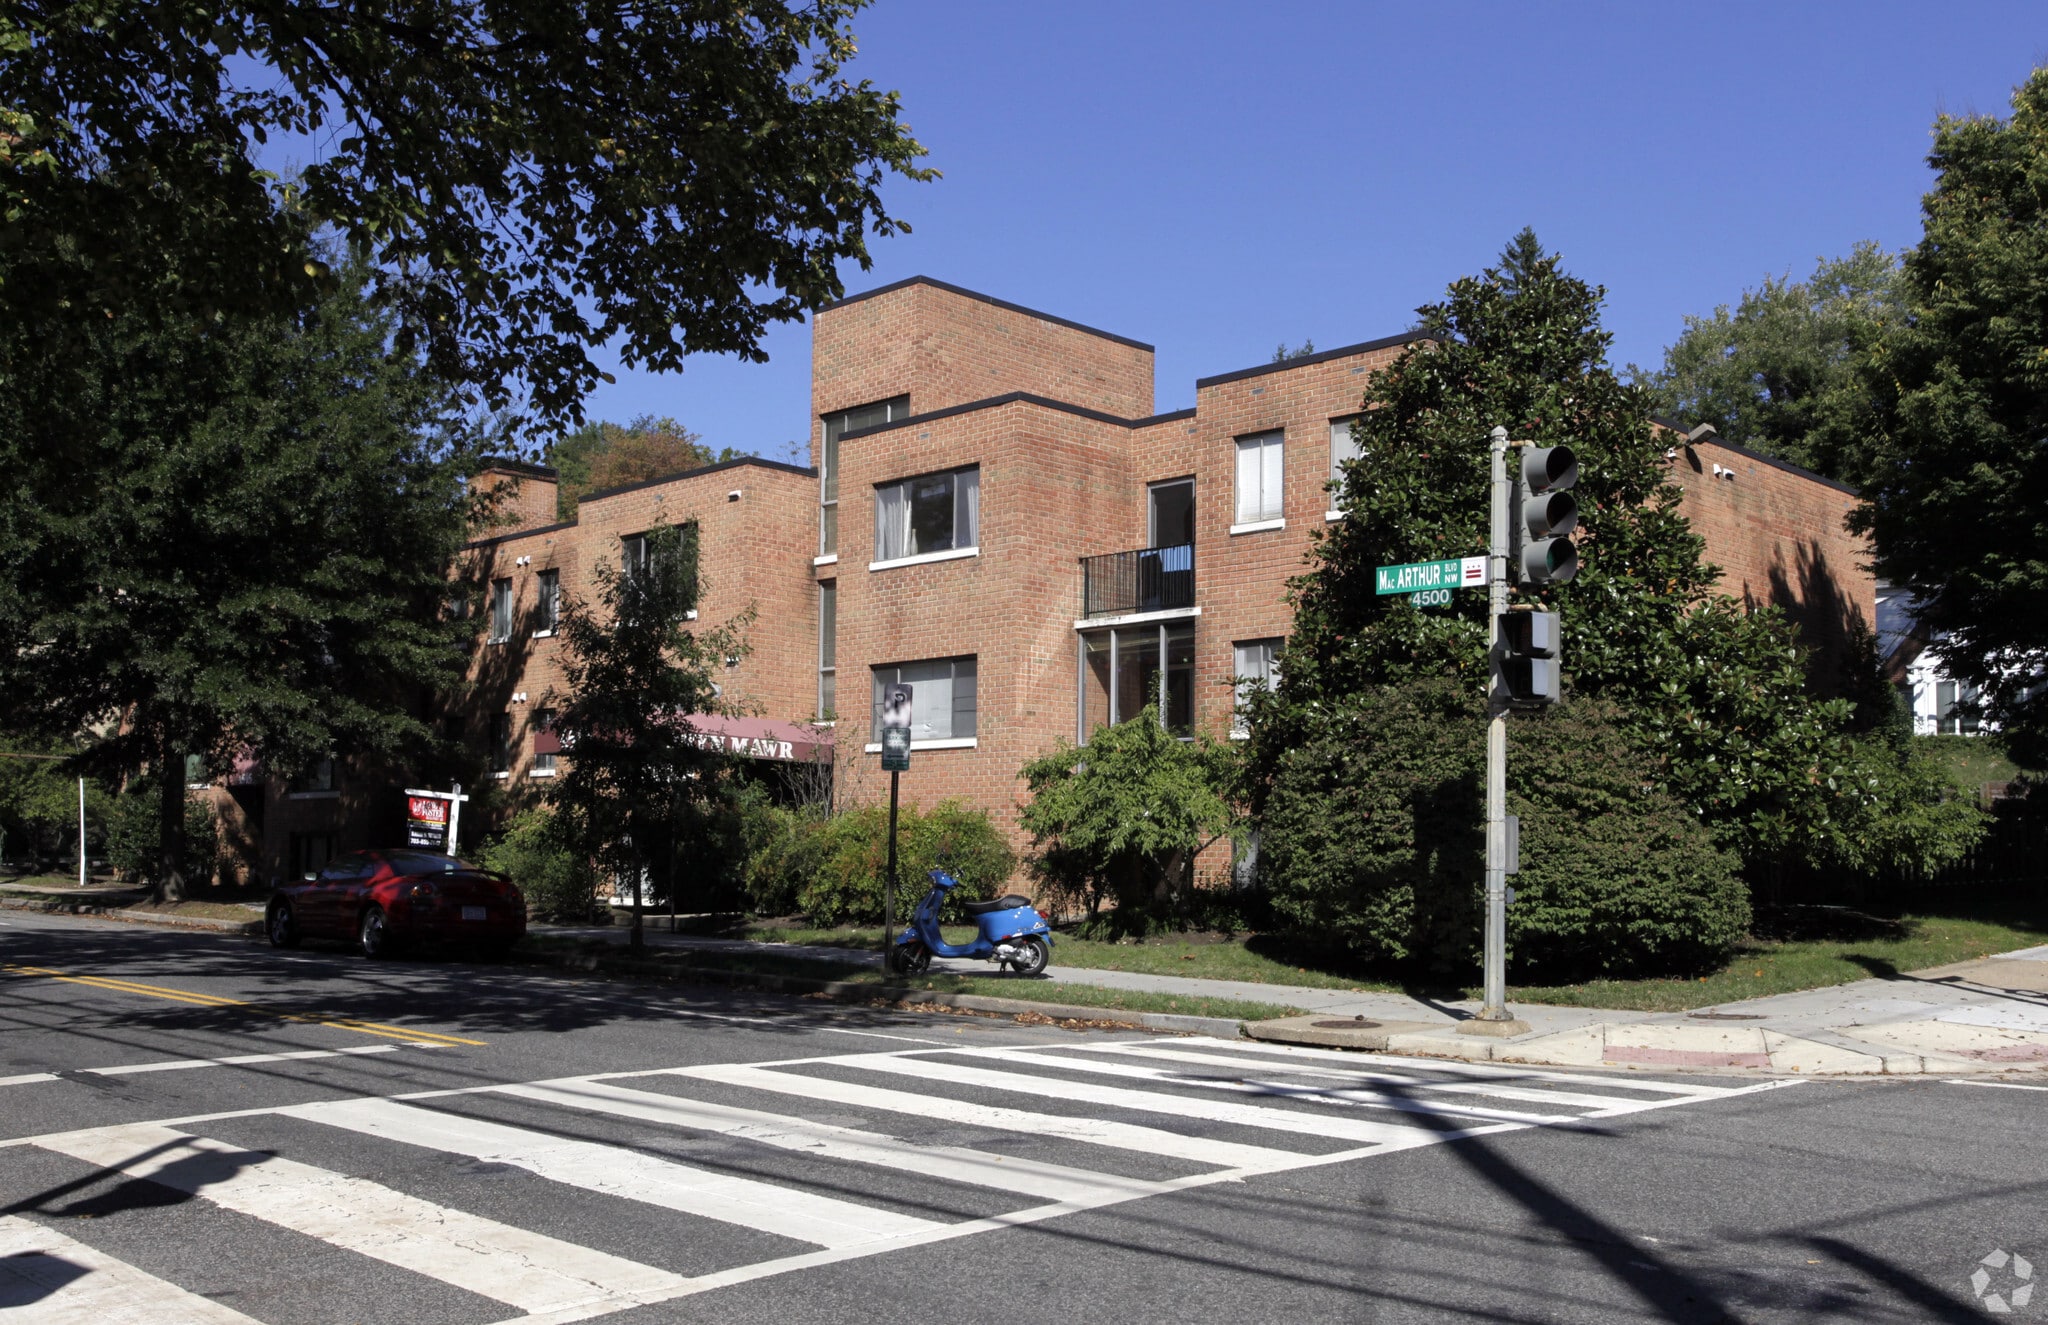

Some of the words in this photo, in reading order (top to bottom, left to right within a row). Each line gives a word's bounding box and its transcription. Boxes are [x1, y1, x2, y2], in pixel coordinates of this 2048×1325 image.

[1444, 562, 1458, 572] BLVD
[1397, 564, 1440, 588] ARTHUR
[1444, 573, 1458, 584] NW
[1412, 589, 1450, 605] 4500
[730, 736, 794, 759] MAWR
